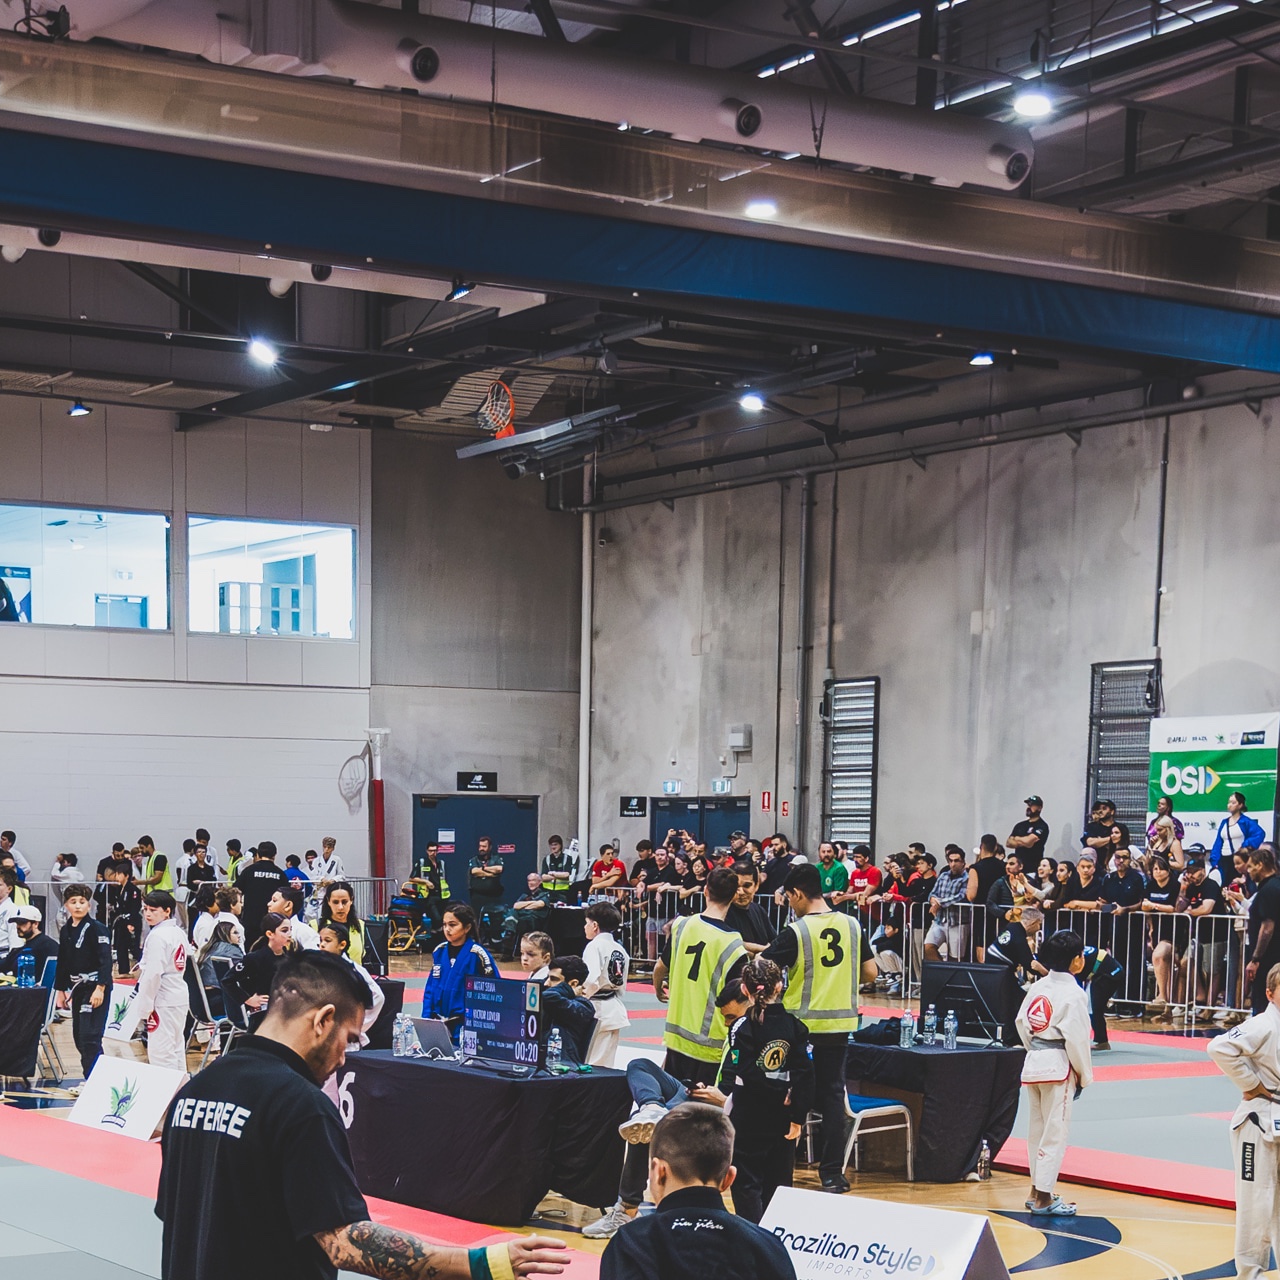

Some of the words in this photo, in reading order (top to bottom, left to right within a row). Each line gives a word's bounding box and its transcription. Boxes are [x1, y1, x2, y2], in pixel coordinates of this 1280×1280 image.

[254, 872, 280, 880] REFEREE
[685, 941, 706, 982] 1
[820, 928, 844, 967] 3
[529, 986, 537, 1008] 6
[528, 1015, 537, 1038] 0
[515, 1041, 538, 1062] 00:20
[339, 1071, 355, 1130] 6
[171, 1098, 252, 1139] REFEREE
[1245, 1145, 1253, 1179] HOOKS
[672, 1218, 693, 1229] jiu
[694, 1219, 724, 1231] jitsu
[807, 1259, 872, 1280] IMPORTS
[863, 1242, 922, 1275] Style
